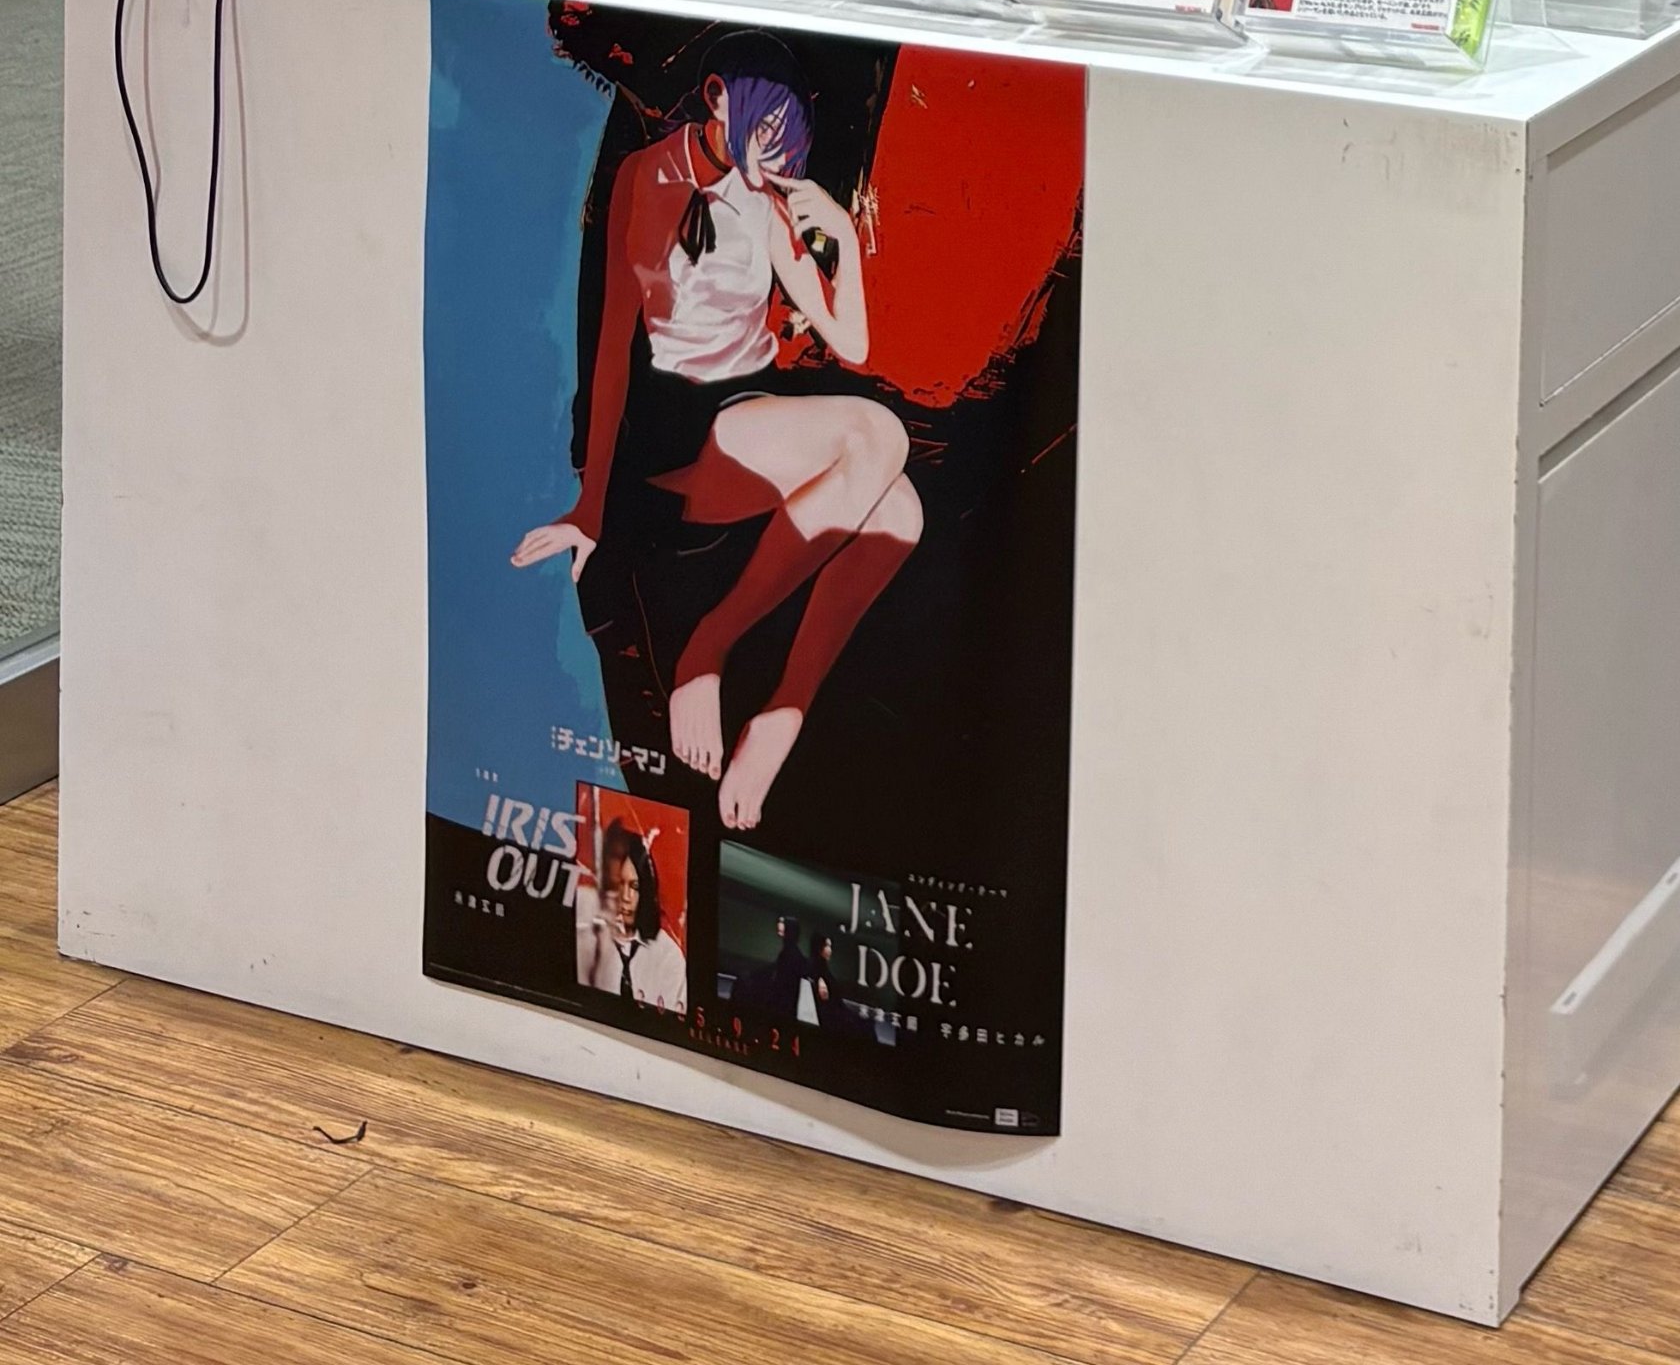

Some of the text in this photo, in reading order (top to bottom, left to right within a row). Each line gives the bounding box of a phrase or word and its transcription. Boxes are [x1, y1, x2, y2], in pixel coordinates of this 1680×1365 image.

[481, 793, 587, 859] IRIS
[486, 844, 592, 908] OUT
[839, 882, 974, 949] JANE
[856, 944, 957, 1008] DOE
